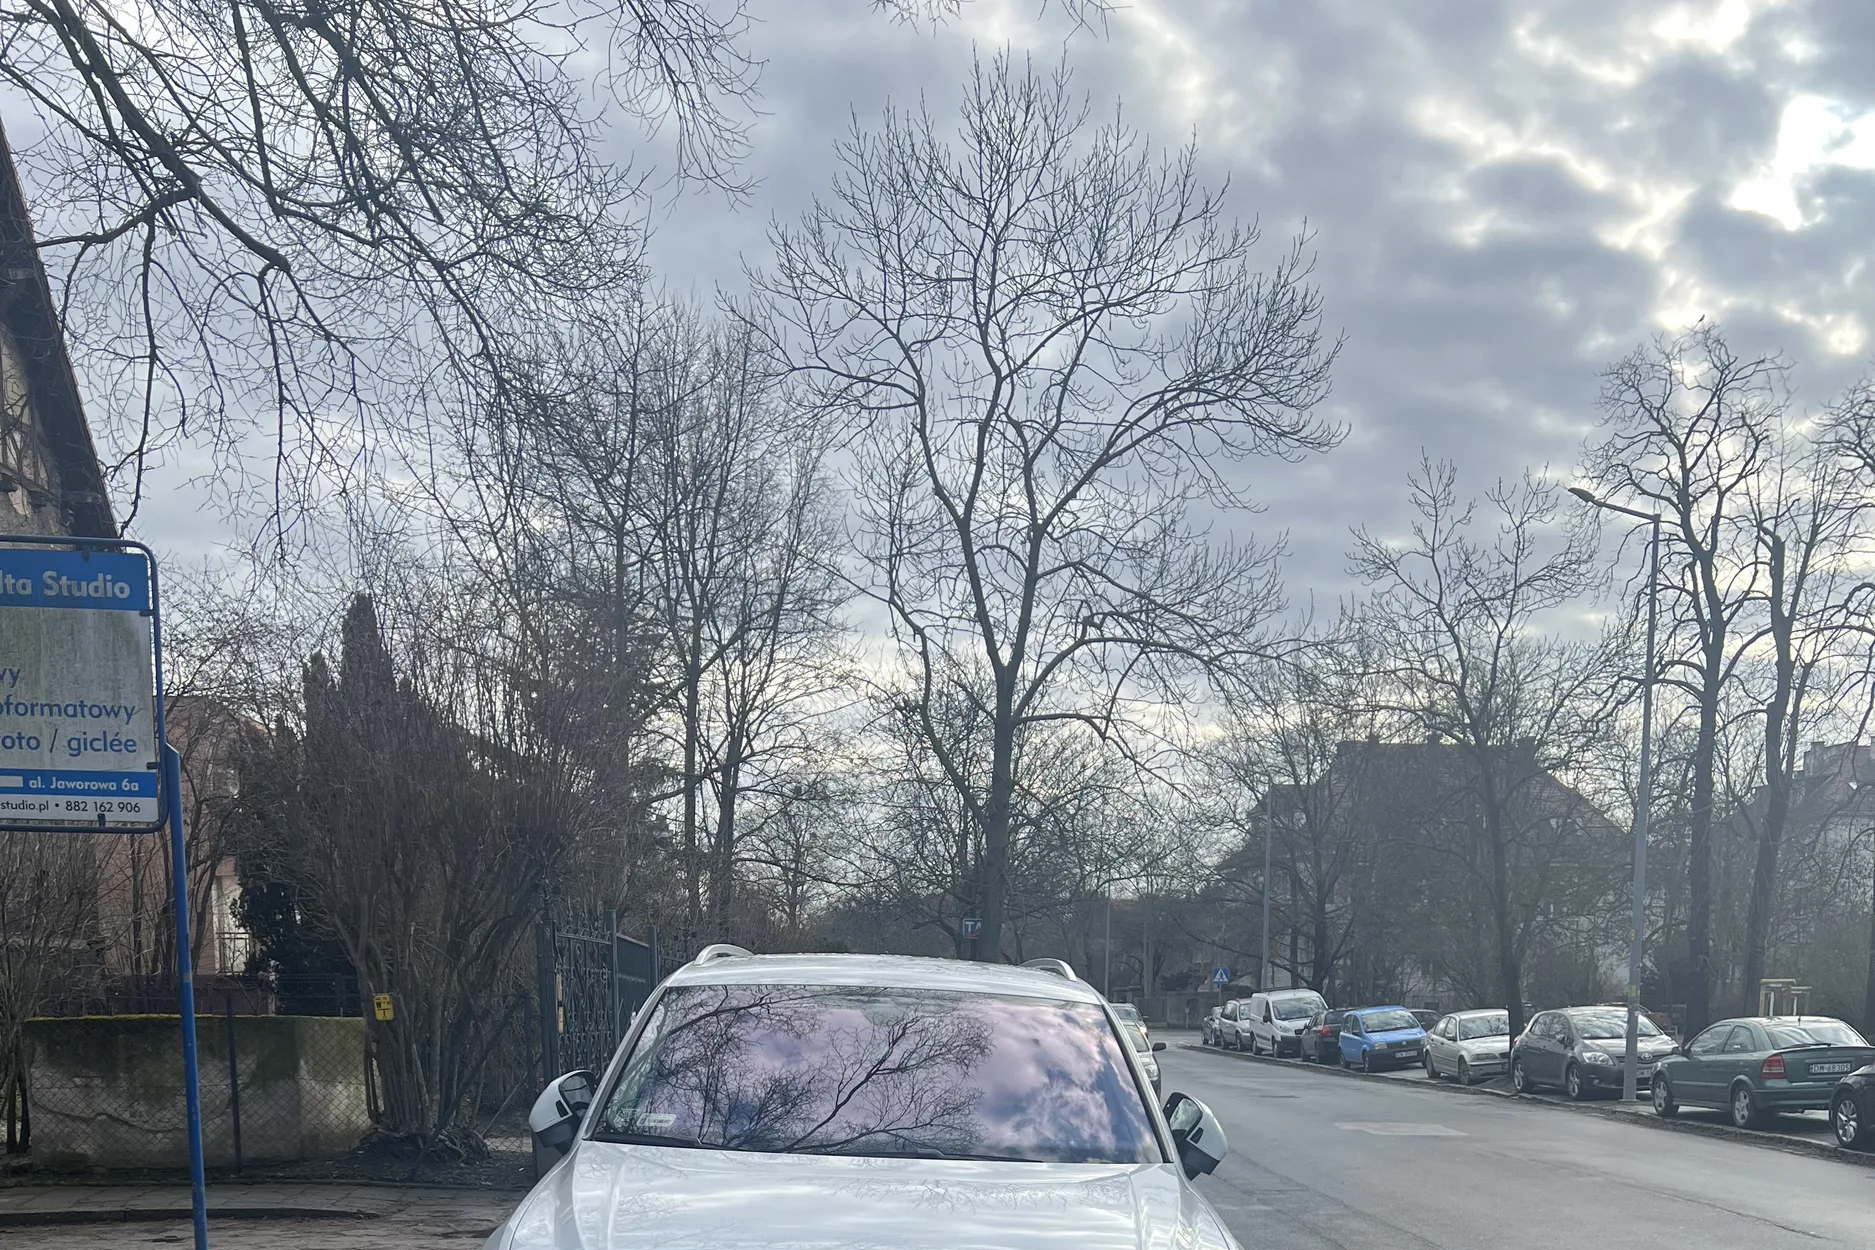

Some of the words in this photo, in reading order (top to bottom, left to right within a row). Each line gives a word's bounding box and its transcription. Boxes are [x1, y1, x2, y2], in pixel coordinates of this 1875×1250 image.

[42, 570, 131, 599] Studio
[0, 694, 136, 725] formatowy
[67, 731, 137, 757] giclée
[29, 776, 46, 789] al.
[50, 776, 117, 791] Jaworowa
[121, 778, 139, 791] 6a
[0, 801, 49, 813] studio.pl
[65, 800, 88, 812] 882
[93, 801, 114, 813] 162
[117, 802, 140, 813] 906
